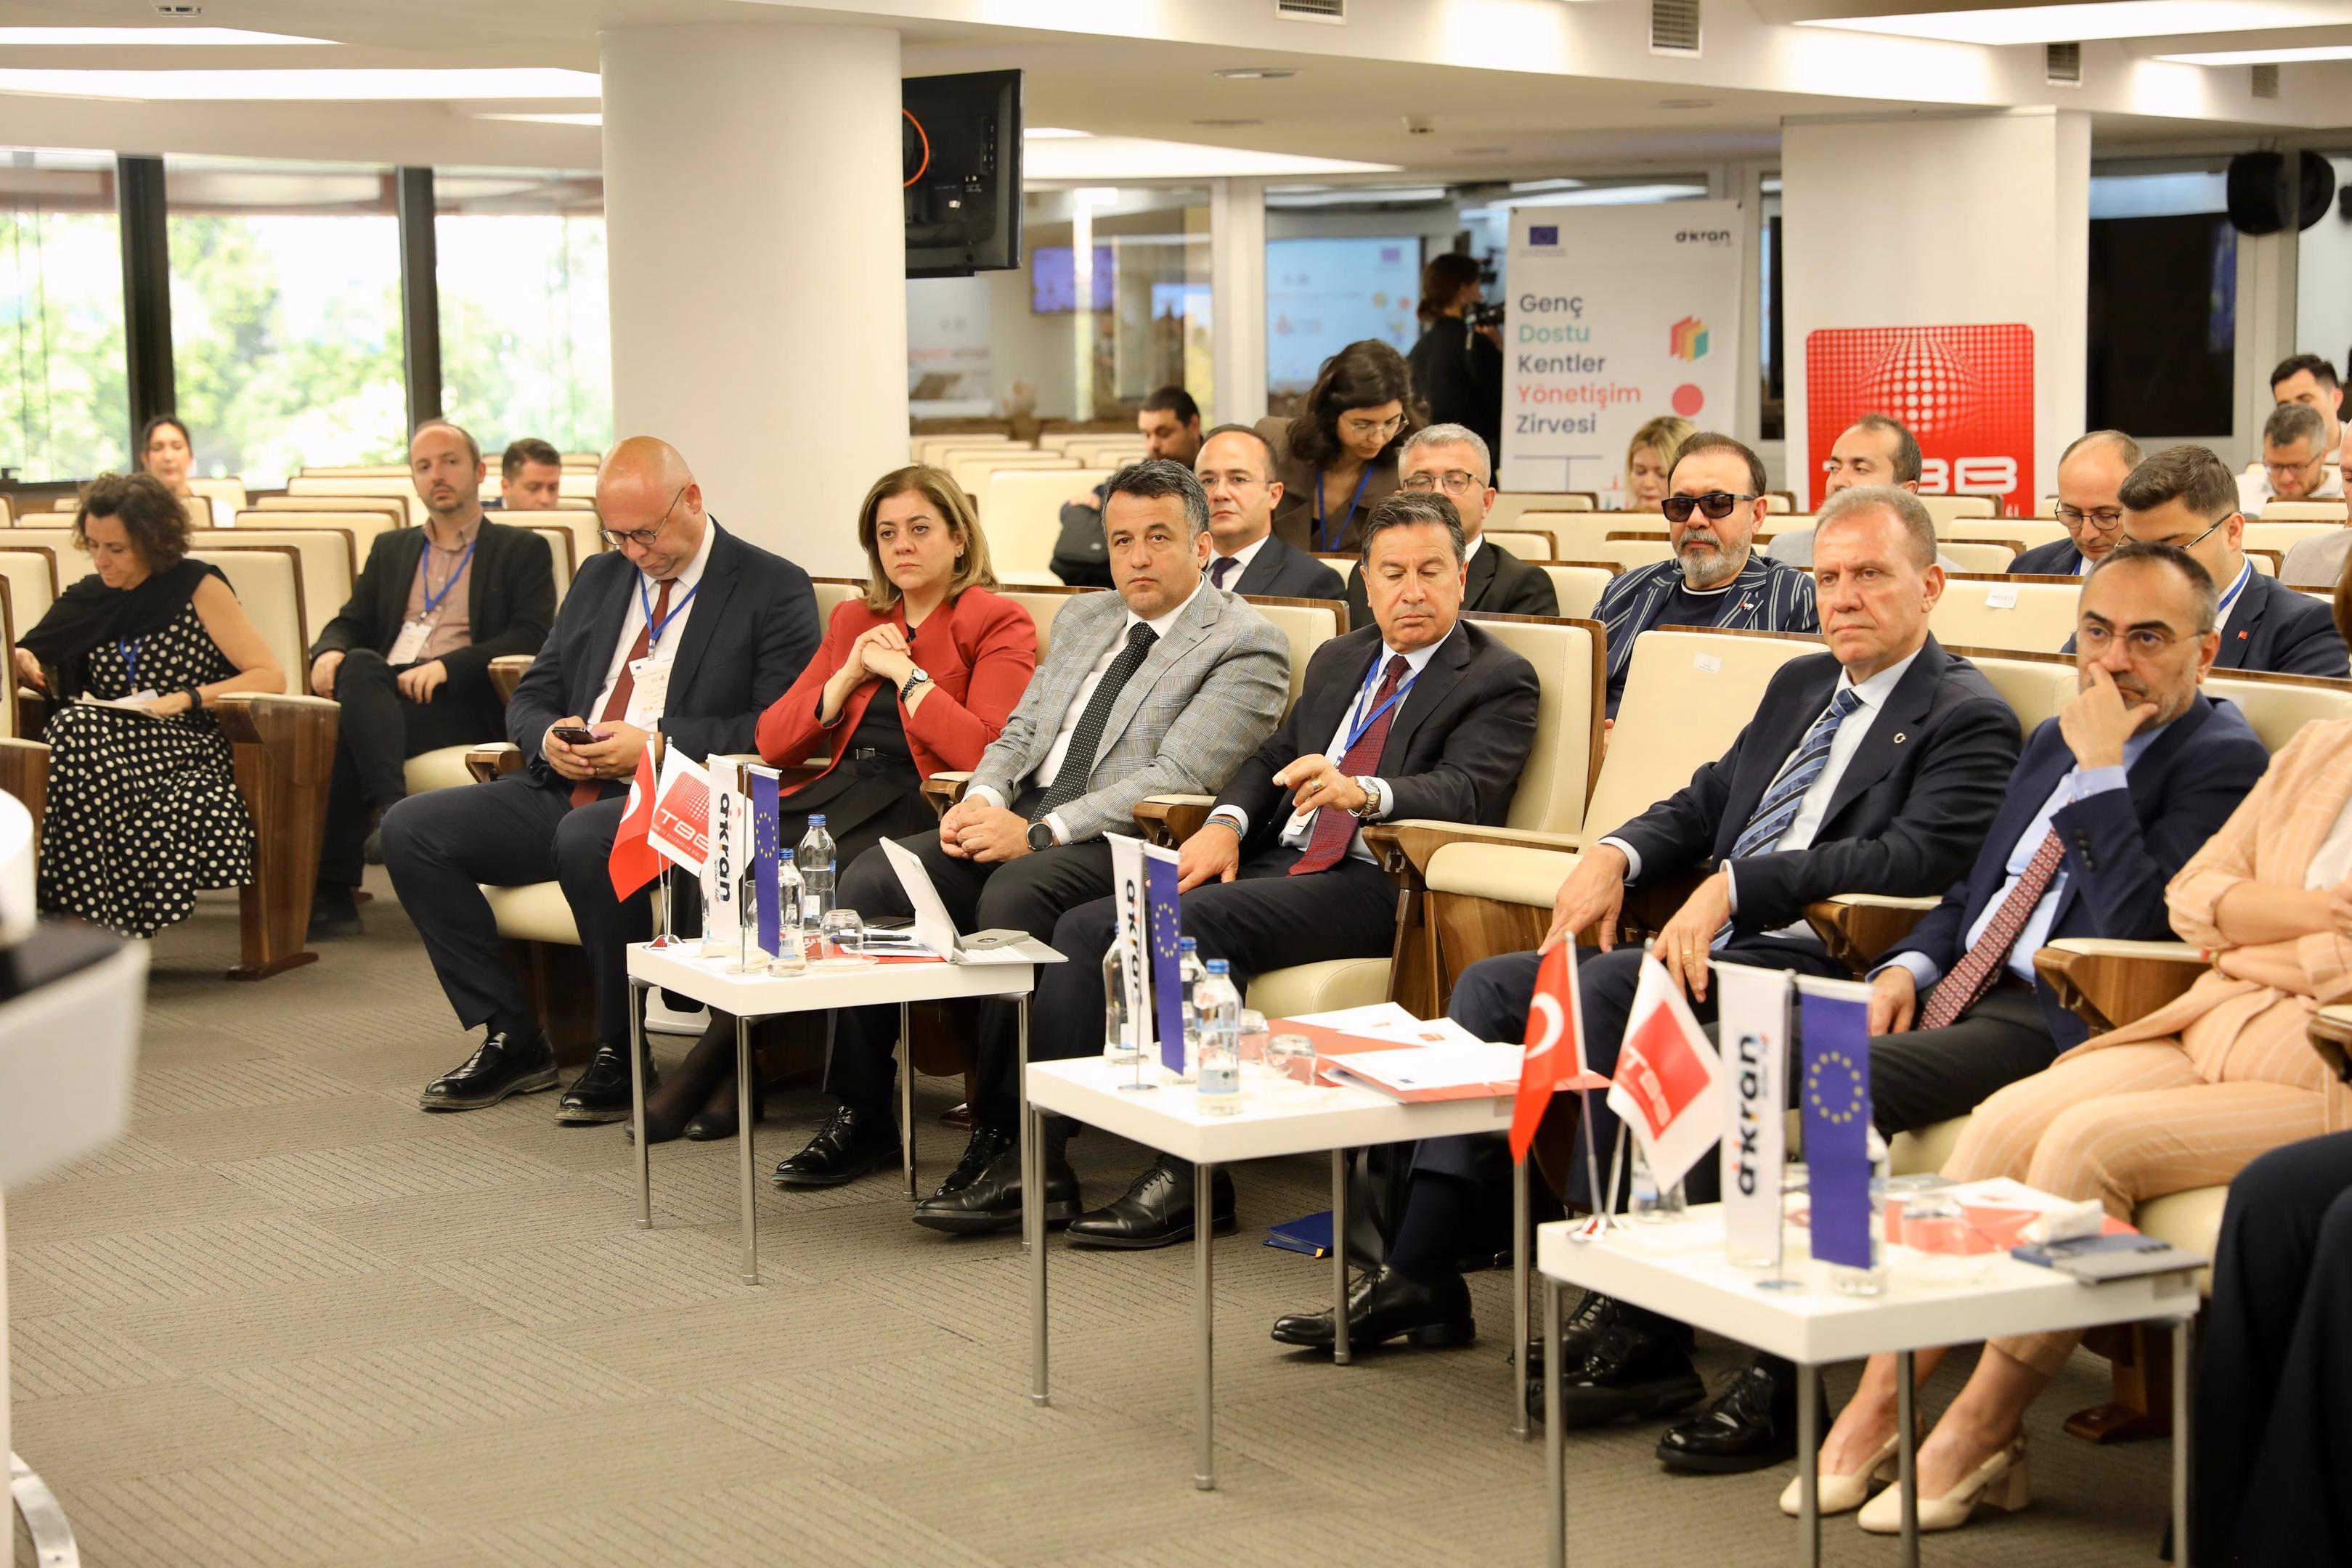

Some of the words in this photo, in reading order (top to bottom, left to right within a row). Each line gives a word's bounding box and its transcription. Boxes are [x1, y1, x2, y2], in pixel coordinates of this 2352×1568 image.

[1519, 293, 1584, 318] Genç
[1518, 324, 1590, 343] Dostu
[1518, 354, 1607, 374] Kentler
[1517, 383, 1641, 409] Yönetişim
[1515, 413, 1596, 434] Zirvesi
